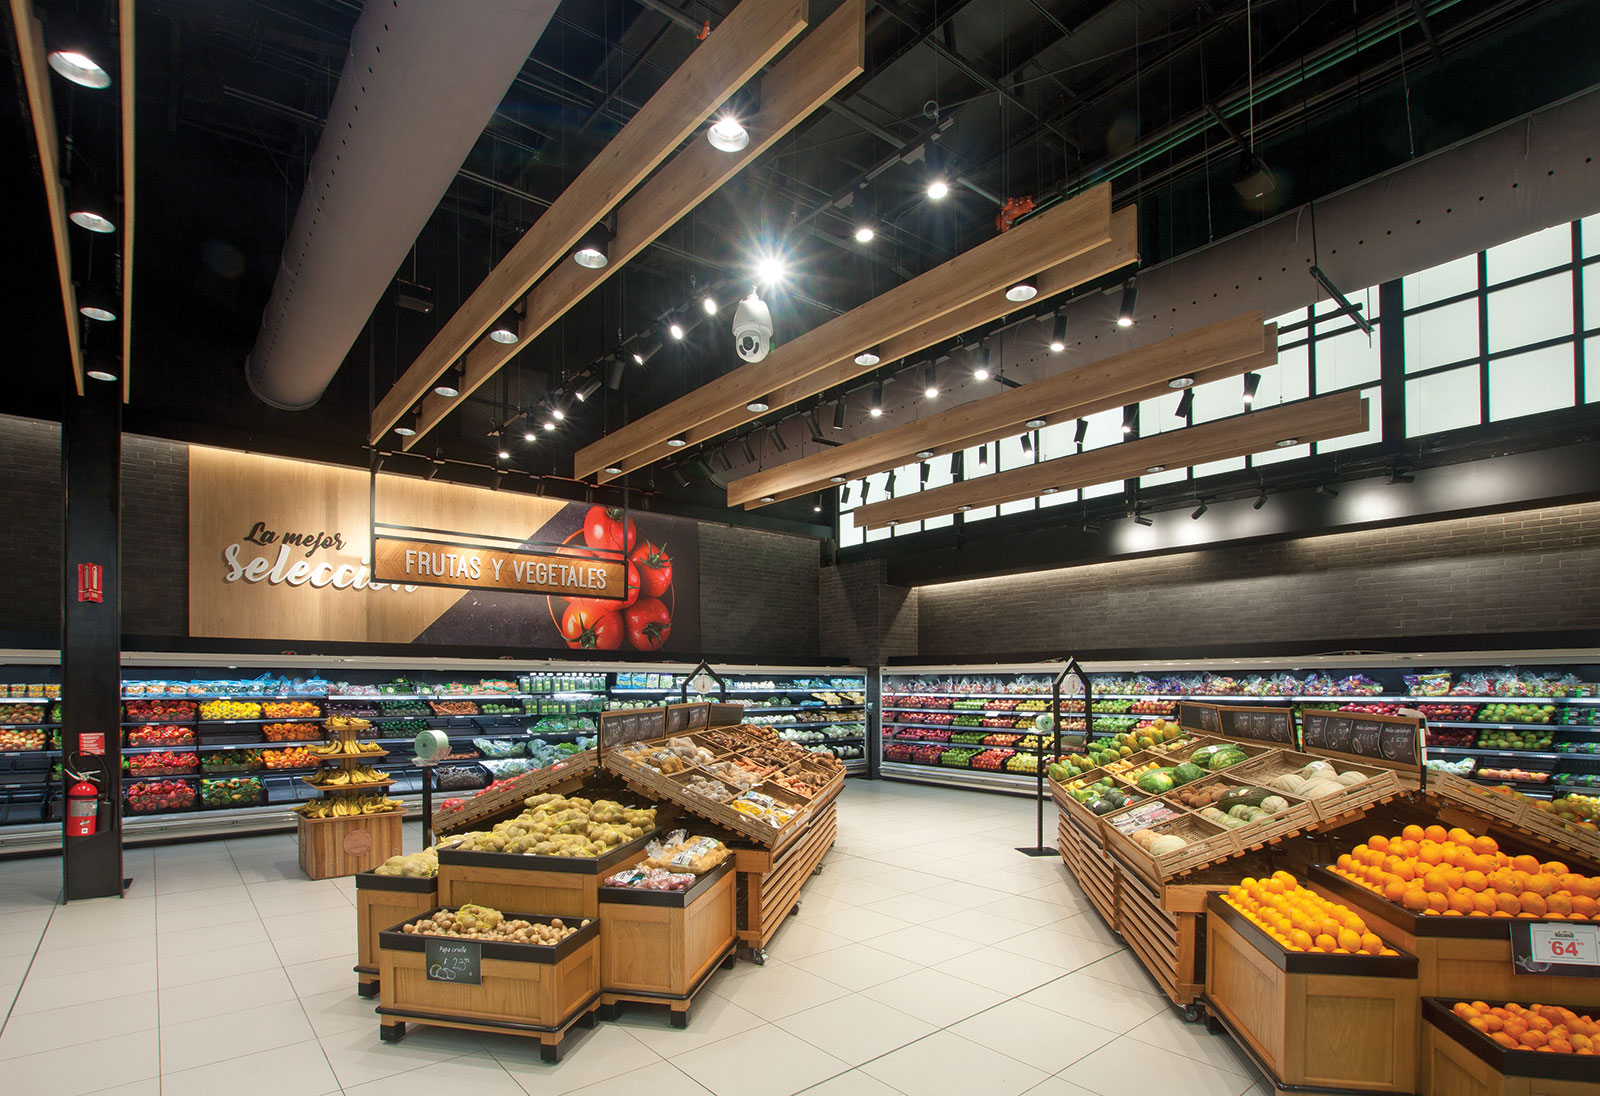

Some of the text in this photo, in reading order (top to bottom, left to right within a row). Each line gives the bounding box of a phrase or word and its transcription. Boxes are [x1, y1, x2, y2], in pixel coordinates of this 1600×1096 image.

[243, 521, 347, 558] La mejor
[224, 543, 420, 593] Selecci
[406, 549, 607, 590] FRUTAS Y VEGETALES
